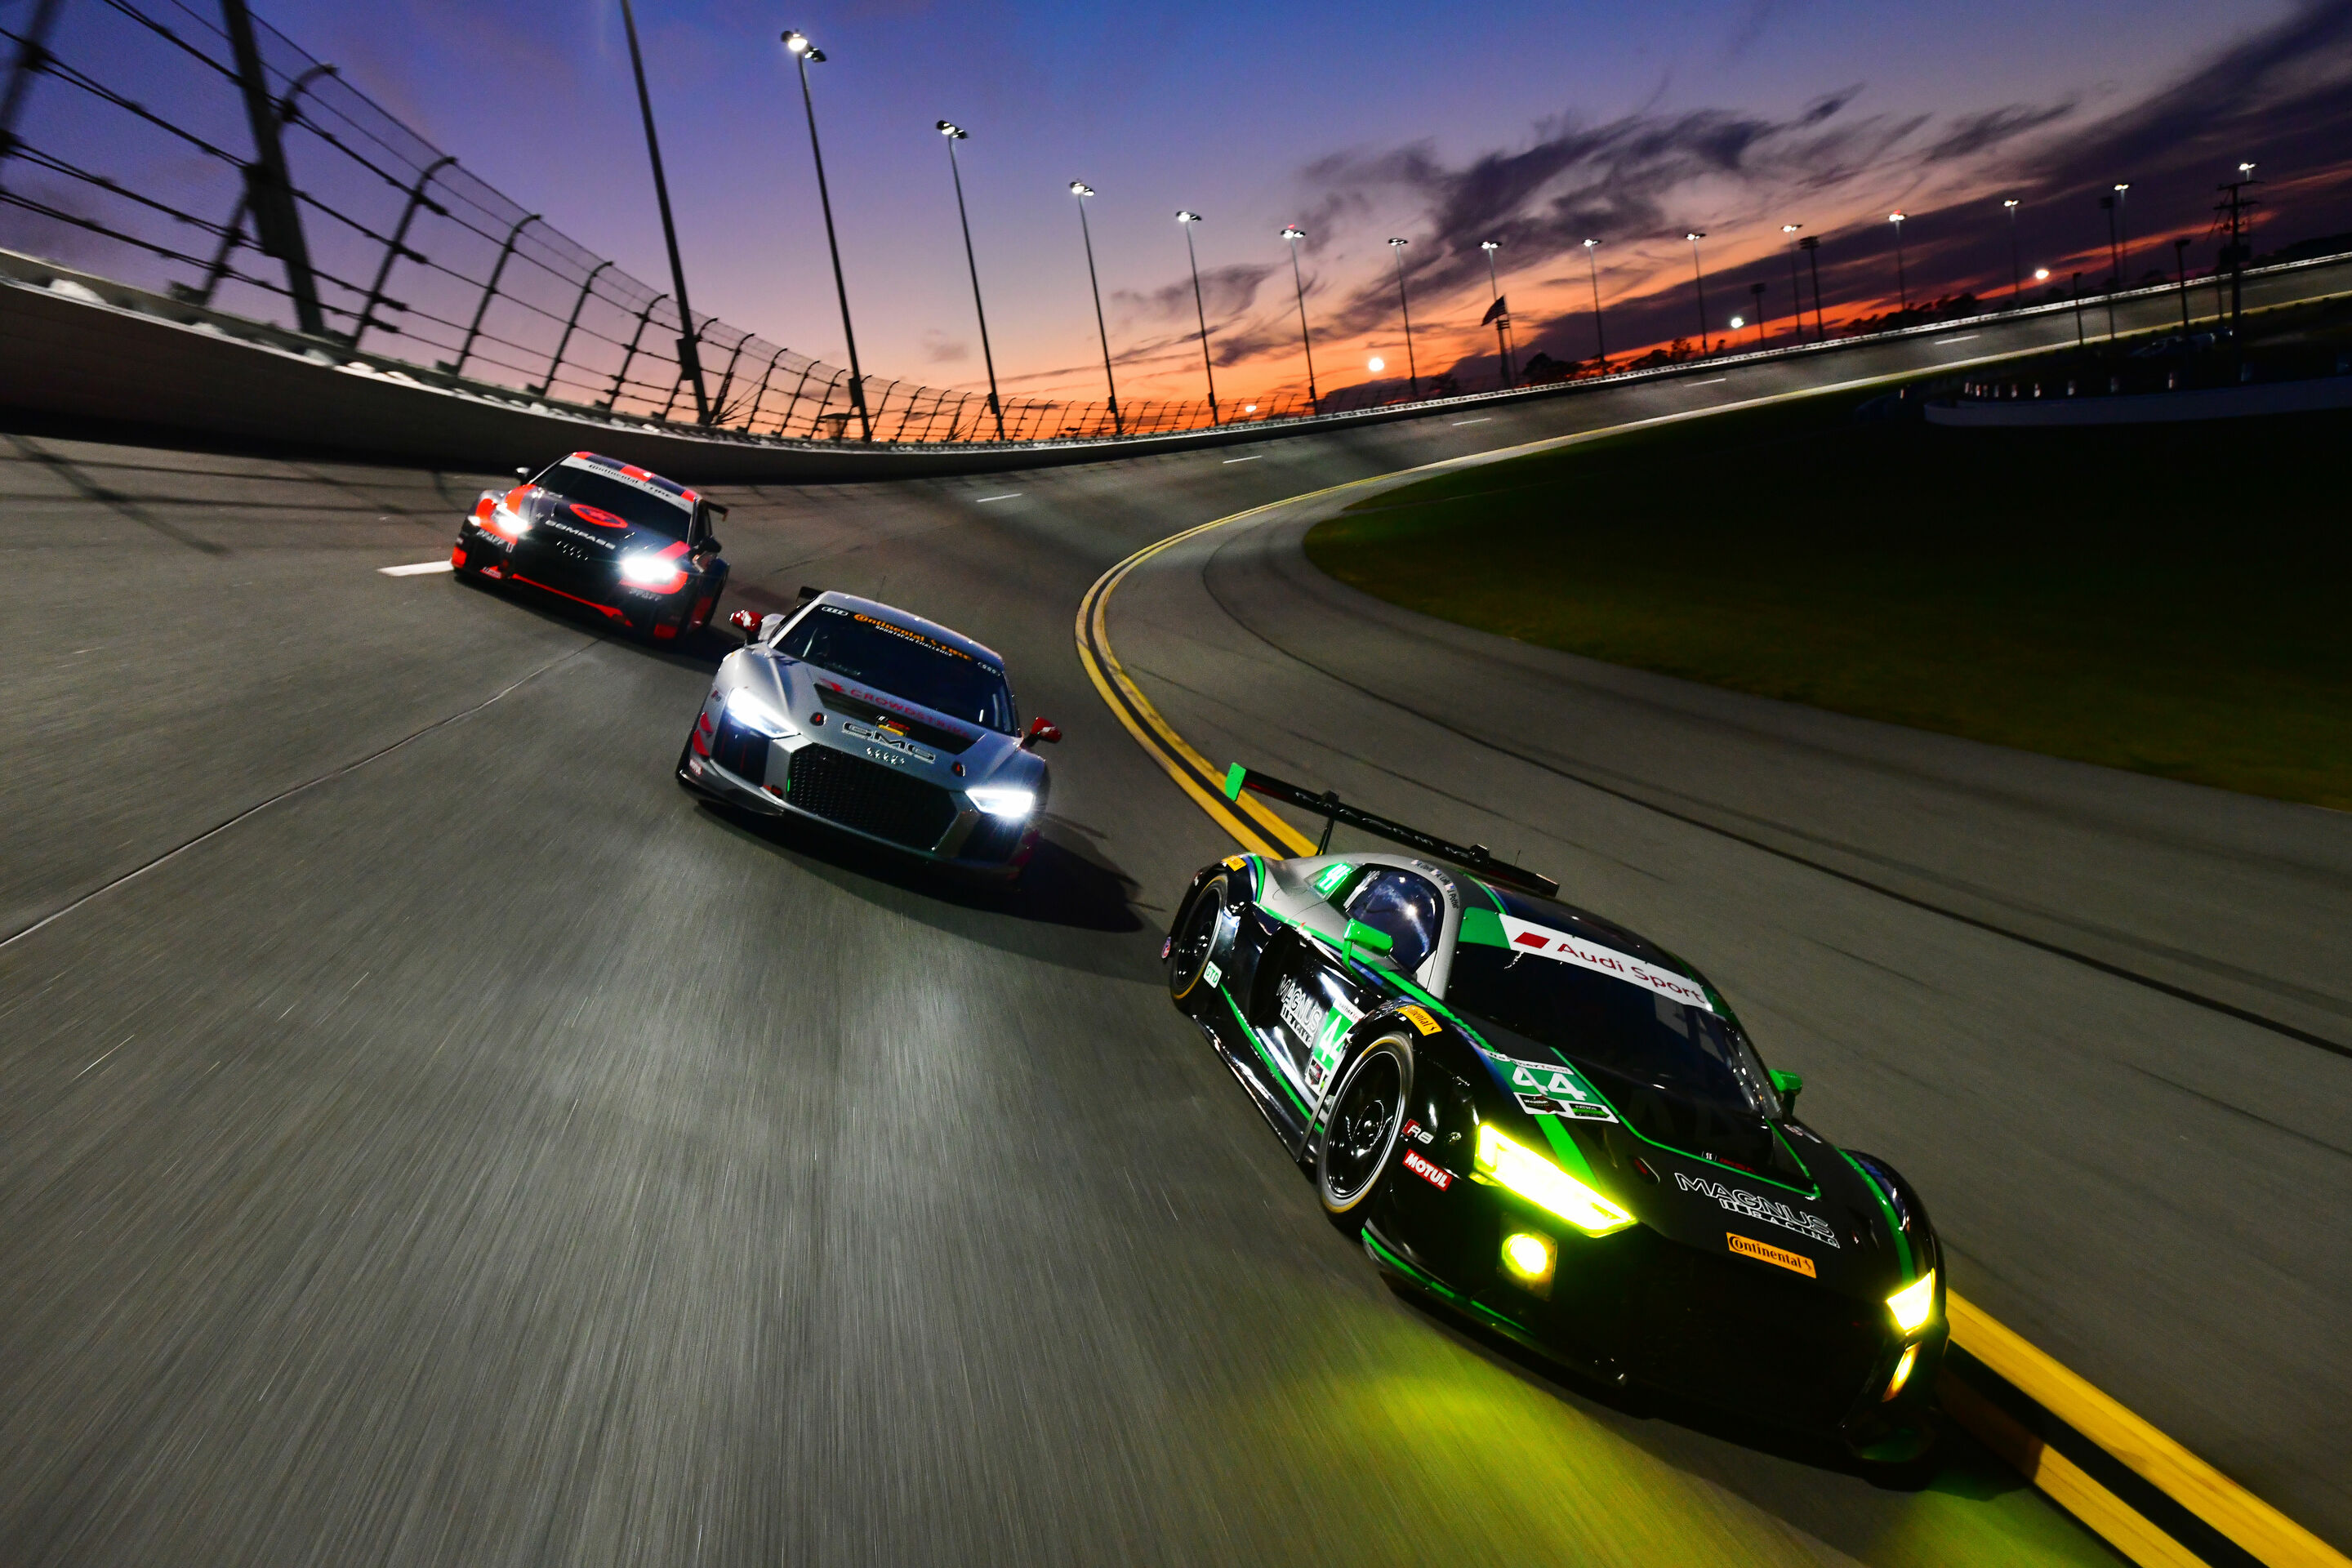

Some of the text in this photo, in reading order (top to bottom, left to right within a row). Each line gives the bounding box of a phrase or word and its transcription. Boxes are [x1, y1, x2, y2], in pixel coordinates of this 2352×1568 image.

[850, 688, 970, 738] CROWDSTRIKE
[1205, 965, 1220, 984] GTD
[1557, 942, 1706, 1004] Audi Sport
[1276, 973, 1323, 1036] MAGNUS
[1512, 1066, 1588, 1102] 44
[1407, 1124, 1435, 1144] R8
[1404, 1152, 1450, 1188] MOTUL
[1674, 1172, 1835, 1239] MAGNUS
[1751, 1209, 1840, 1249] RACING
[1729, 1235, 1802, 1268] Continental
